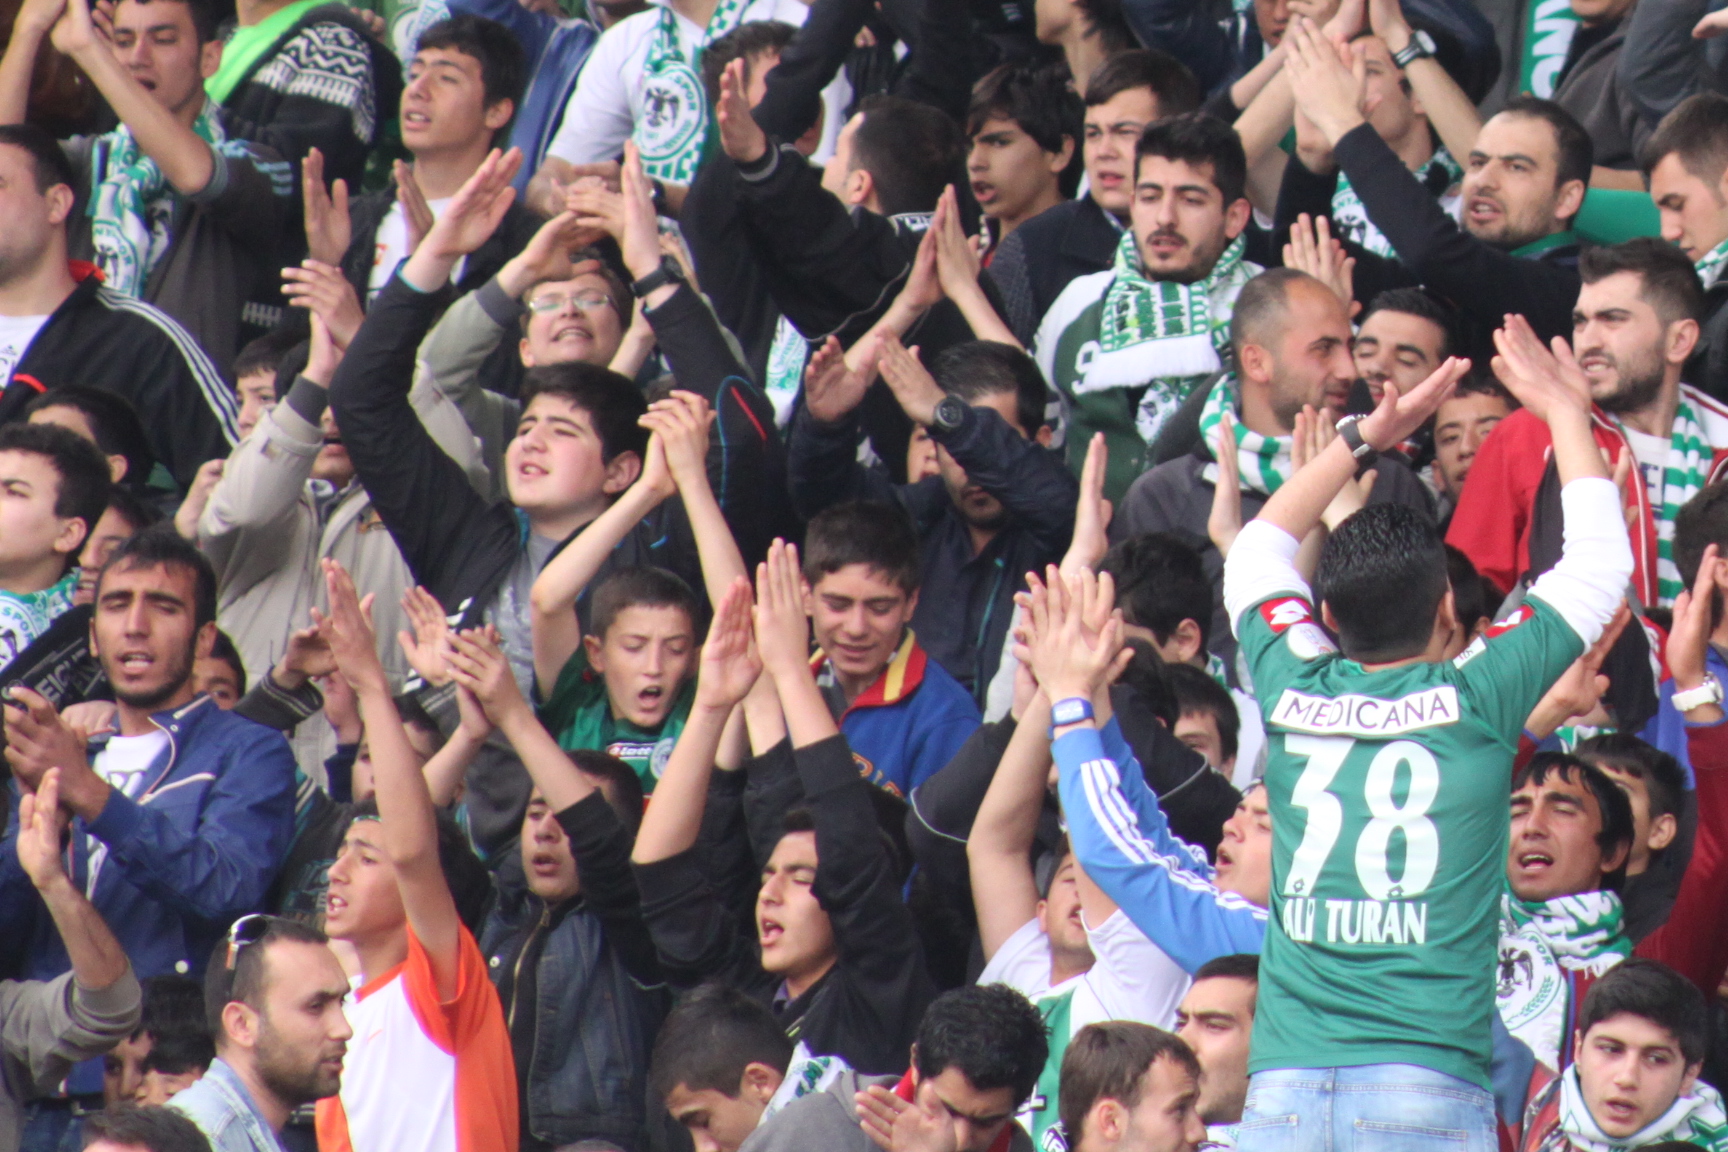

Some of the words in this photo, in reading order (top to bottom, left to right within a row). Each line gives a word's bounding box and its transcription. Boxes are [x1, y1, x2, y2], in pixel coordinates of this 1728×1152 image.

[1282, 692, 1451, 729] MEDICANA
[1284, 733, 1440, 901] 38
[1324, 899, 1427, 944] TURAN
